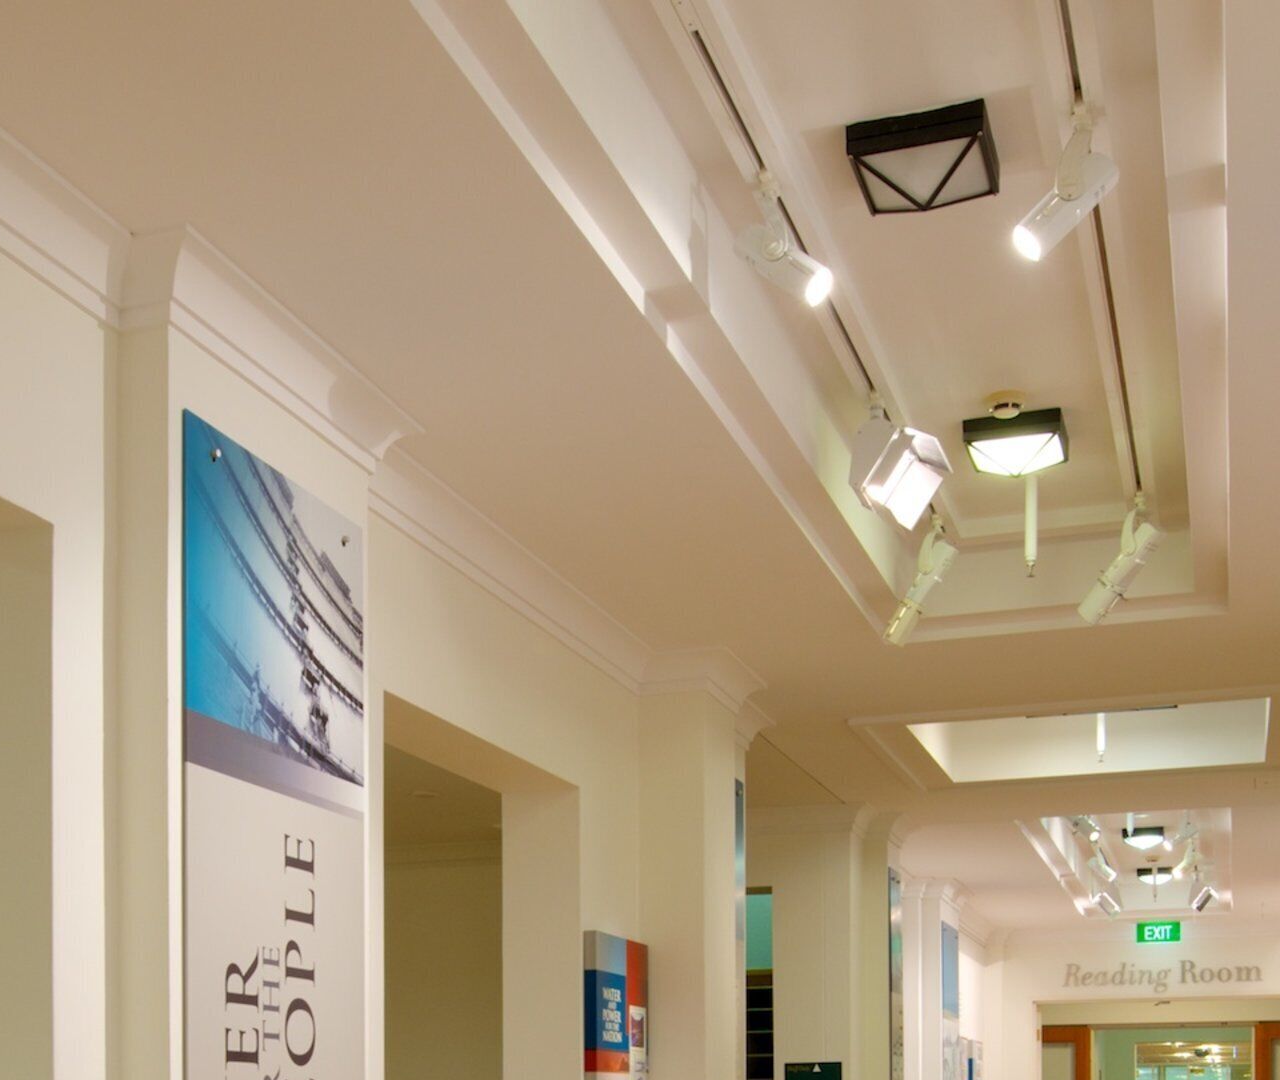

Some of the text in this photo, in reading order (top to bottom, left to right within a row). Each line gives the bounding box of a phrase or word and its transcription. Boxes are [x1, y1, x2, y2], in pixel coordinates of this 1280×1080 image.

[1144, 925, 1173, 941] EXIT
[1061, 958, 1264, 994] Reading Room
[262, 945, 282, 1053] THE
